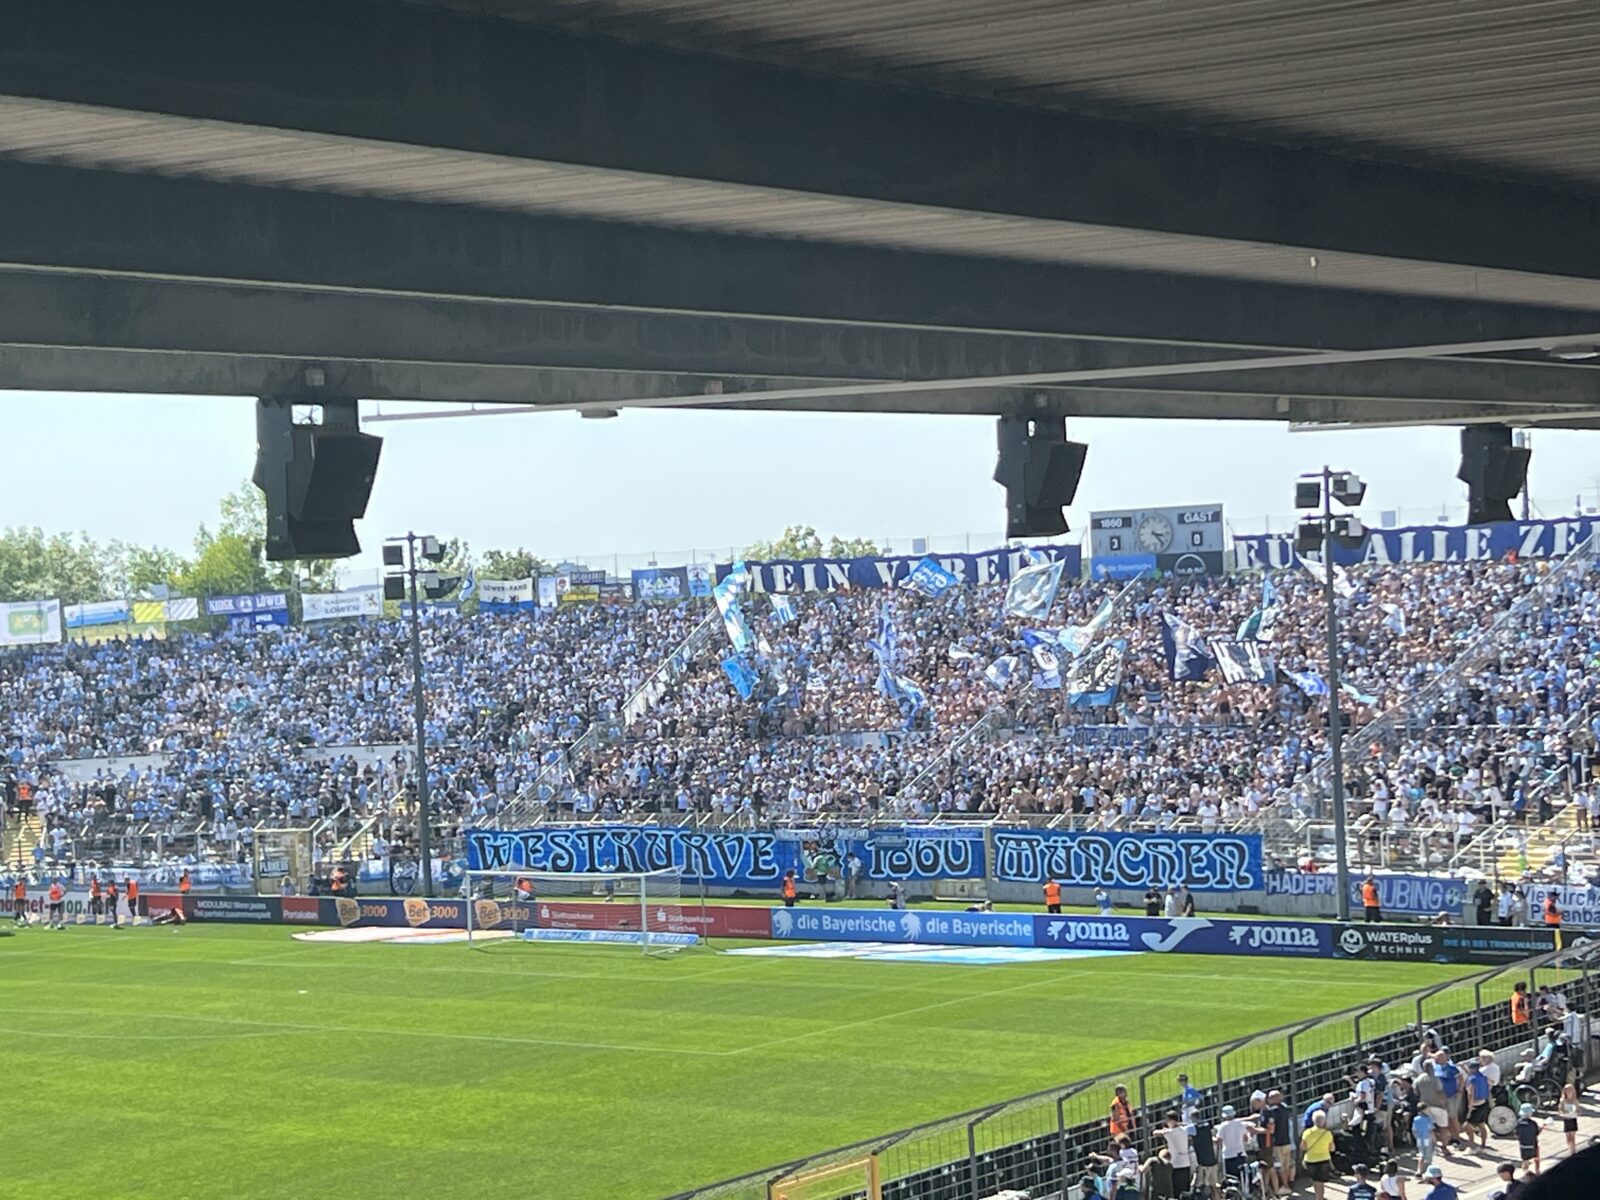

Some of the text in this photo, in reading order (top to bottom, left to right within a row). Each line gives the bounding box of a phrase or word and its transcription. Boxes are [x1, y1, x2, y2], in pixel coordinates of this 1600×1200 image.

[1100, 518, 1123, 528] 1860
[1183, 511, 1213, 523] GAST
[1111, 538, 1118, 549] 3
[1193, 533, 1201, 545] 0
[1363, 529, 1492, 565] ALLE
[473, 833, 778, 879] WESTKURVE
[959, 885, 966, 894] 4
[797, 916, 895, 937] die Bayerische
[926, 918, 1031, 941] die Bayerische
[1366, 931, 1432, 945] WATERplus
[1374, 945, 1425, 955] TECHNIK
